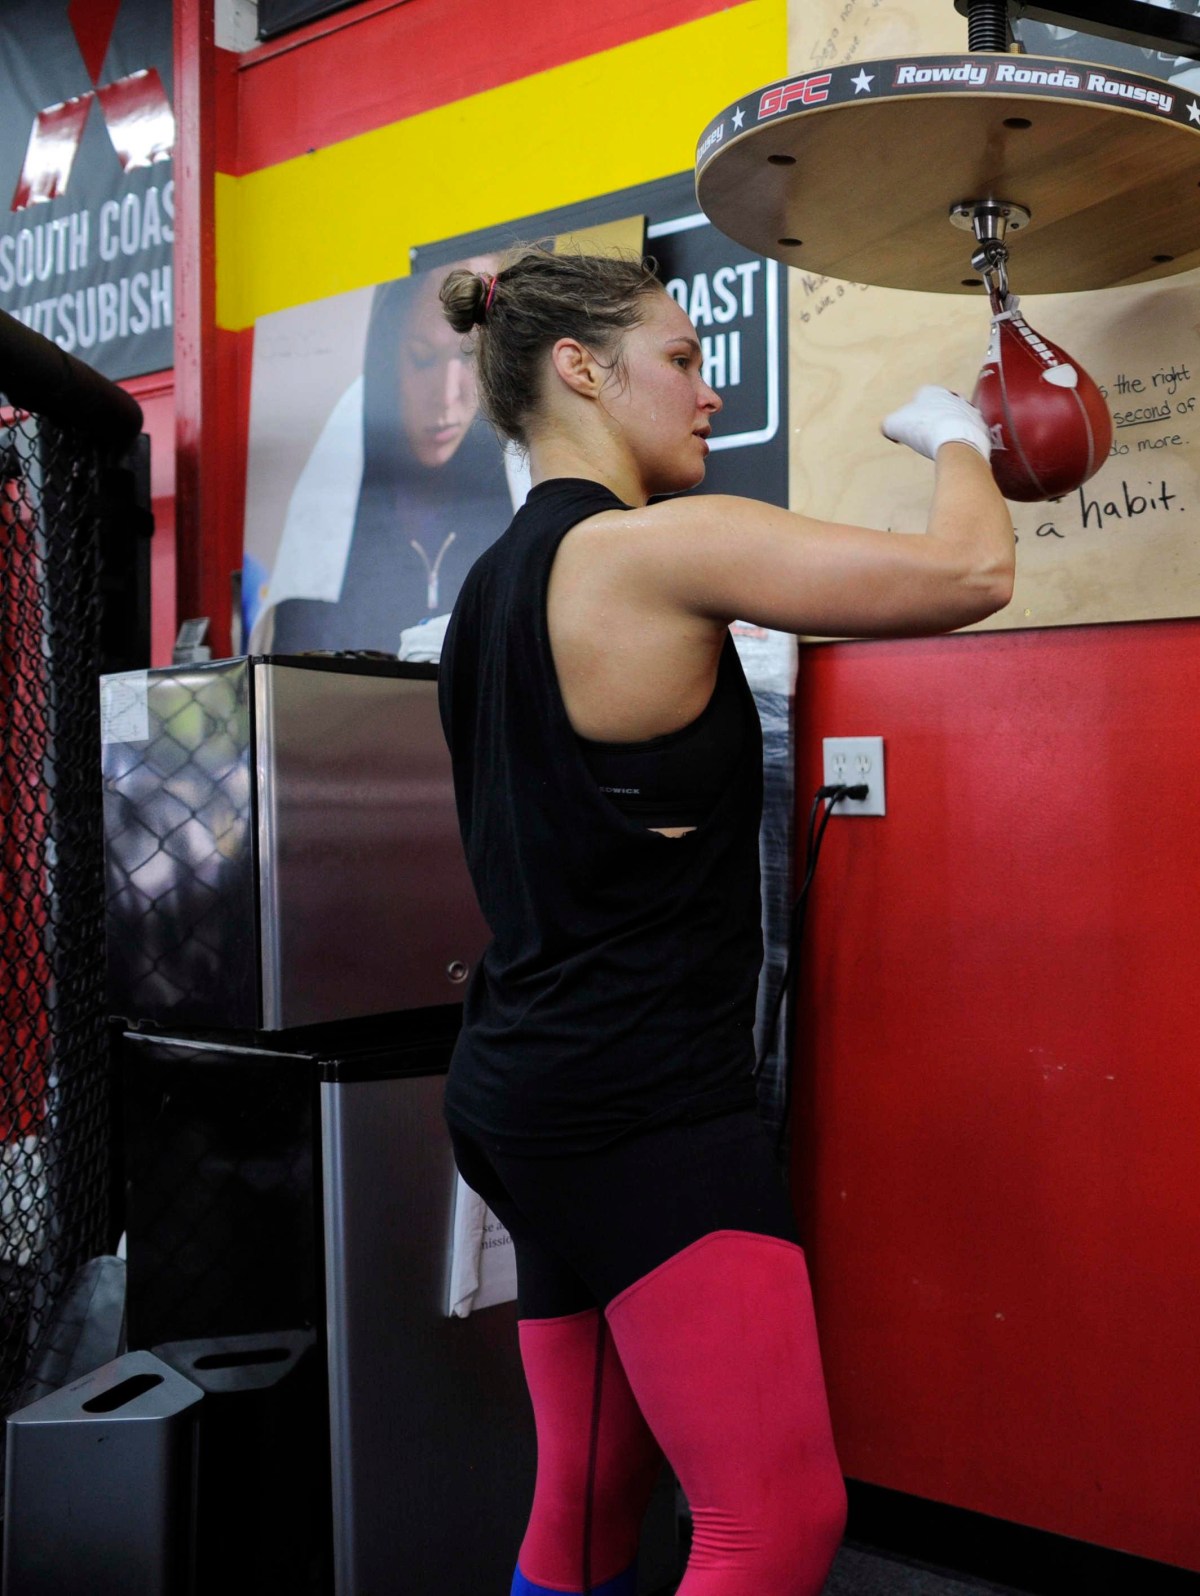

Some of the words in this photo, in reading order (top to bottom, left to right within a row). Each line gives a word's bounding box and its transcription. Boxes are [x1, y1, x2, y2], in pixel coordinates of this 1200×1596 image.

[758, 73, 832, 120] GFC
[897, 63, 989, 86] Rowdy
[995, 64, 1080, 90] Ronda
[1087, 74, 1173, 112] Rousey
[0, 209, 89, 292] SOUTH
[100, 180, 175, 261] COAS
[1113, 374, 1146, 395] the
[1152, 364, 1191, 395] right
[1113, 400, 1172, 426] second
[1176, 397, 1196, 415] of
[1137, 434, 1190, 452] more.
[1036, 522, 1065, 538] a
[1080, 480, 1186, 529] habit.
